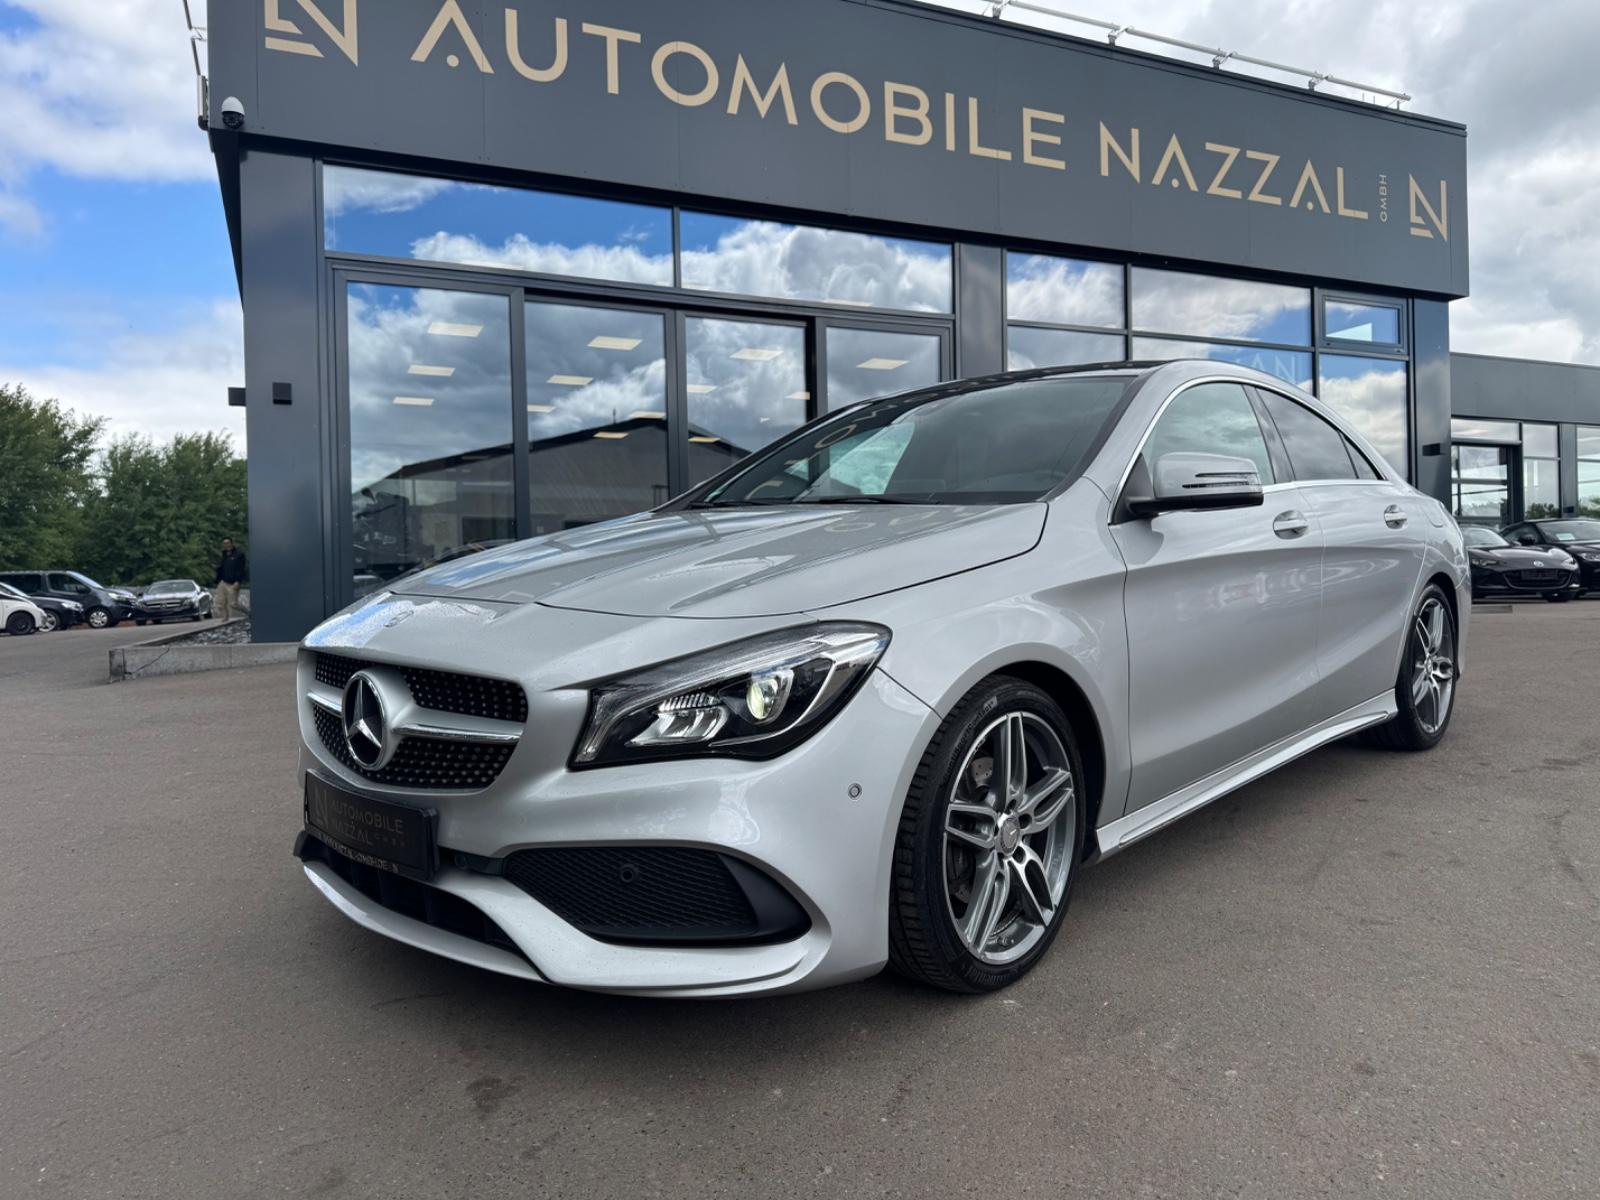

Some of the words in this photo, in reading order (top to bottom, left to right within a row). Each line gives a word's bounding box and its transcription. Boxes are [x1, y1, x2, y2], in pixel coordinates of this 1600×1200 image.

[411, 0, 1066, 170] AUTOMOBILE
[1100, 121, 1368, 220] NAZZAL
[329, 798, 405, 835] AUTOMOBILE
